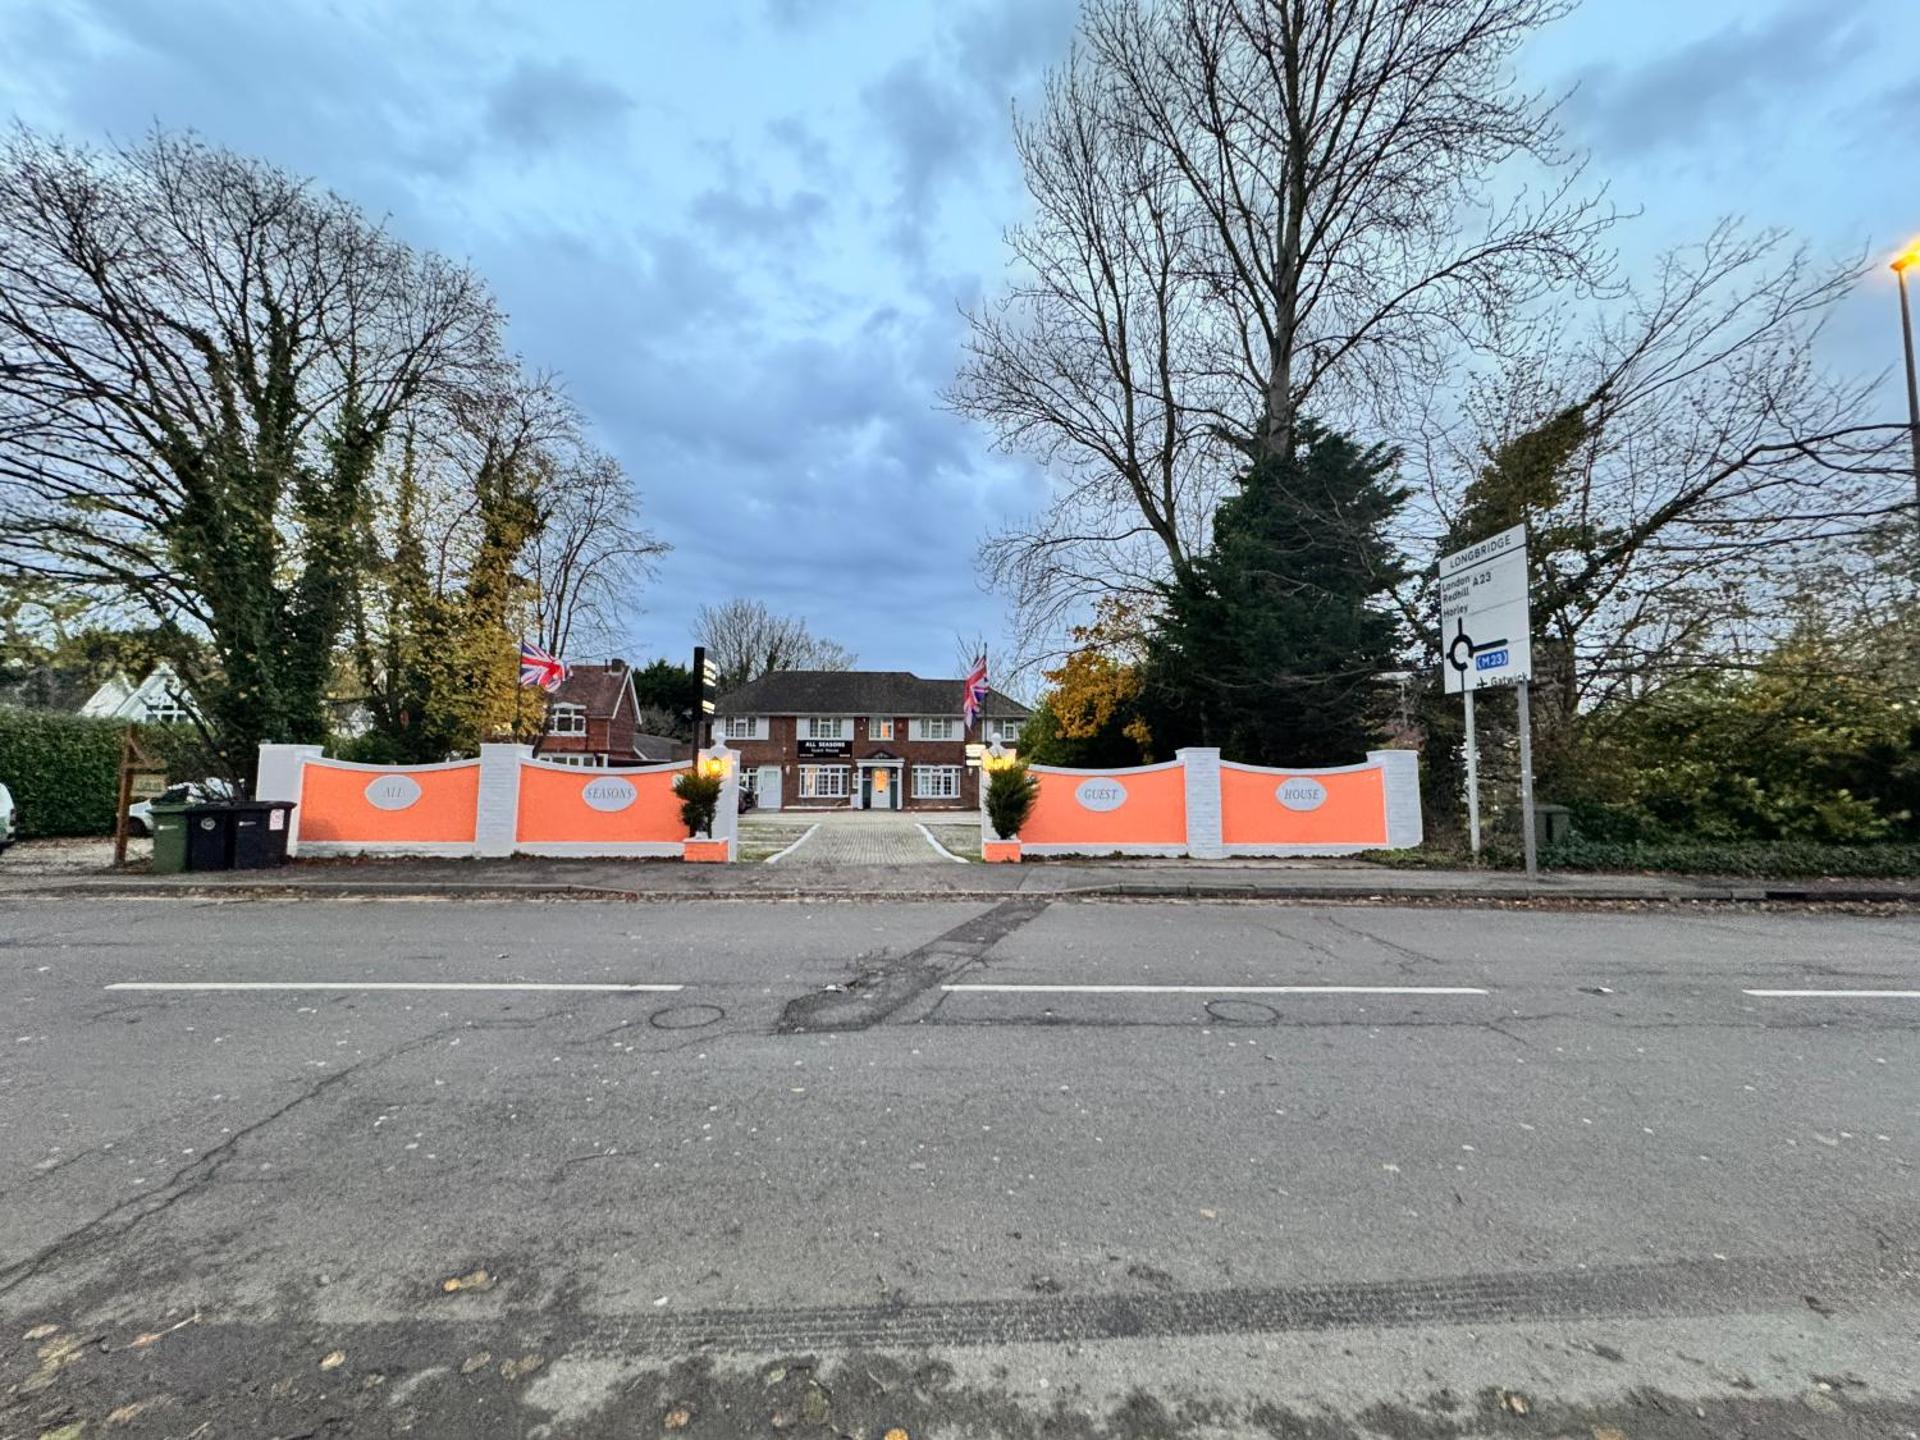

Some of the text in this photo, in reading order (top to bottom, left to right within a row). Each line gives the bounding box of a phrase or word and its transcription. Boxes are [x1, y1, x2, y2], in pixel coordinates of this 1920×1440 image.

[1450, 535, 1511, 568] LONGBRIDGE
[1442, 572, 1491, 592] London A23
[1443, 587, 1469, 603] Redhill
[1443, 605, 1468, 618] Horley
[1491, 672, 1528, 686] Gatwick
[587, 787, 633, 801] SEASONS
[1084, 788, 1119, 800] GUEST
[1284, 788, 1320, 801] HOUSE
